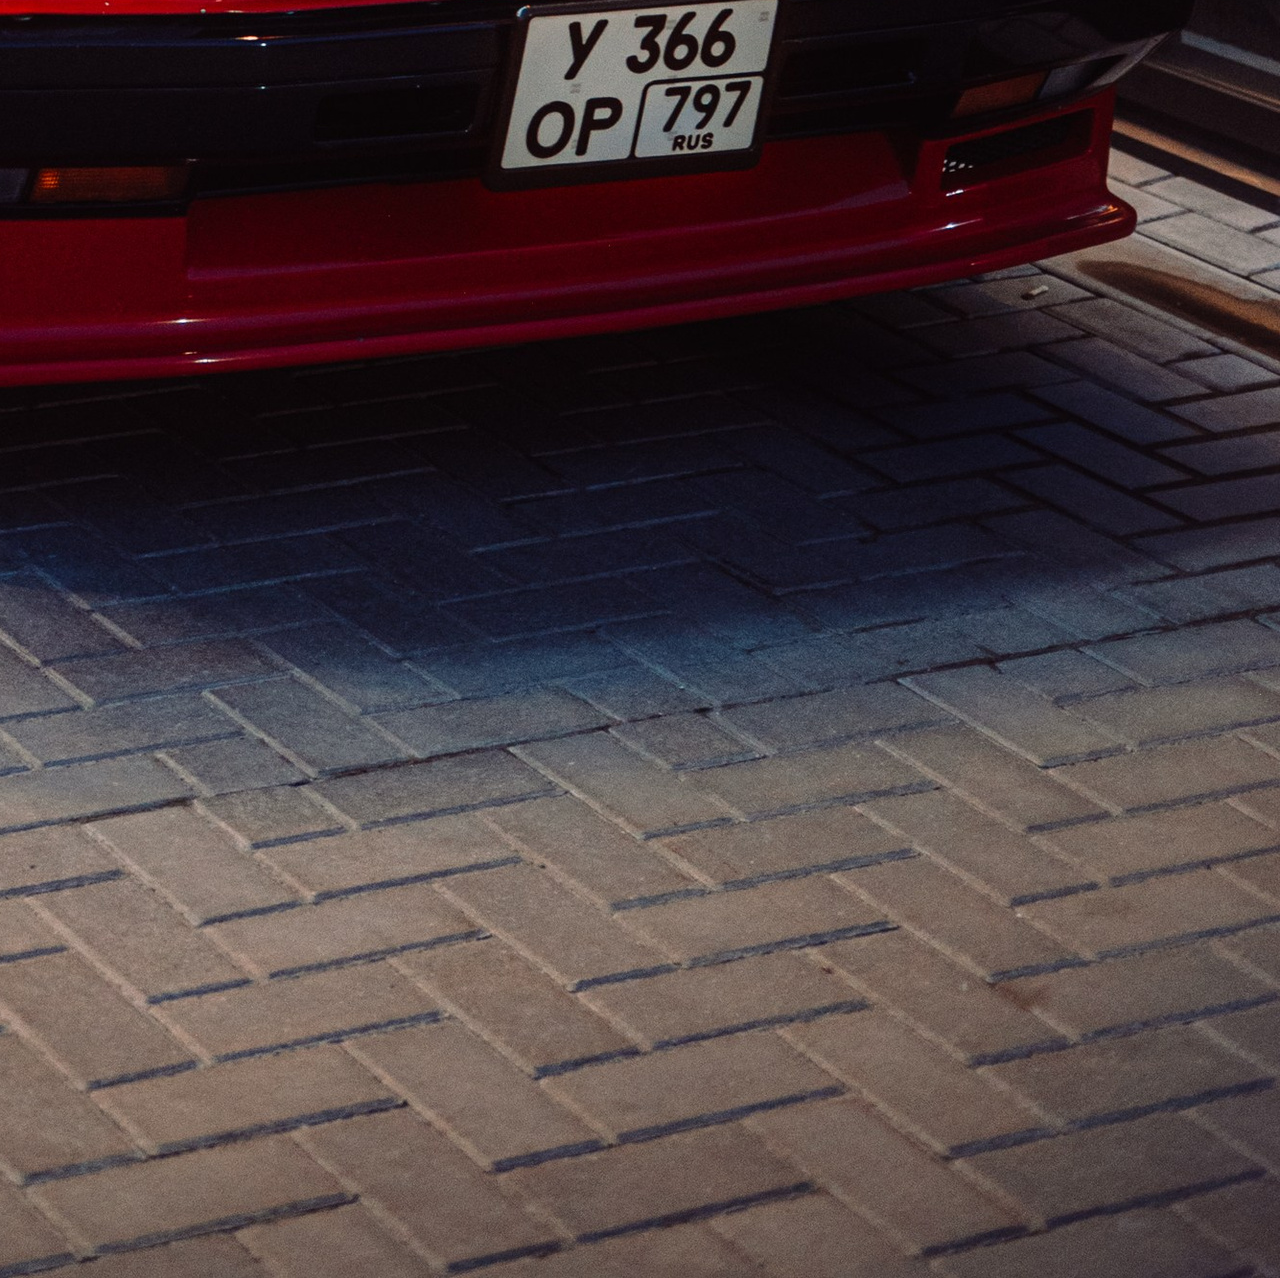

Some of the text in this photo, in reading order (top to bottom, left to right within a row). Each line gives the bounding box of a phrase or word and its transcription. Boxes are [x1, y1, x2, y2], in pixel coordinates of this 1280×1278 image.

[625, 8, 736, 74] 366
[663, 80, 752, 132] 797
[672, 133, 714, 151] RUS
